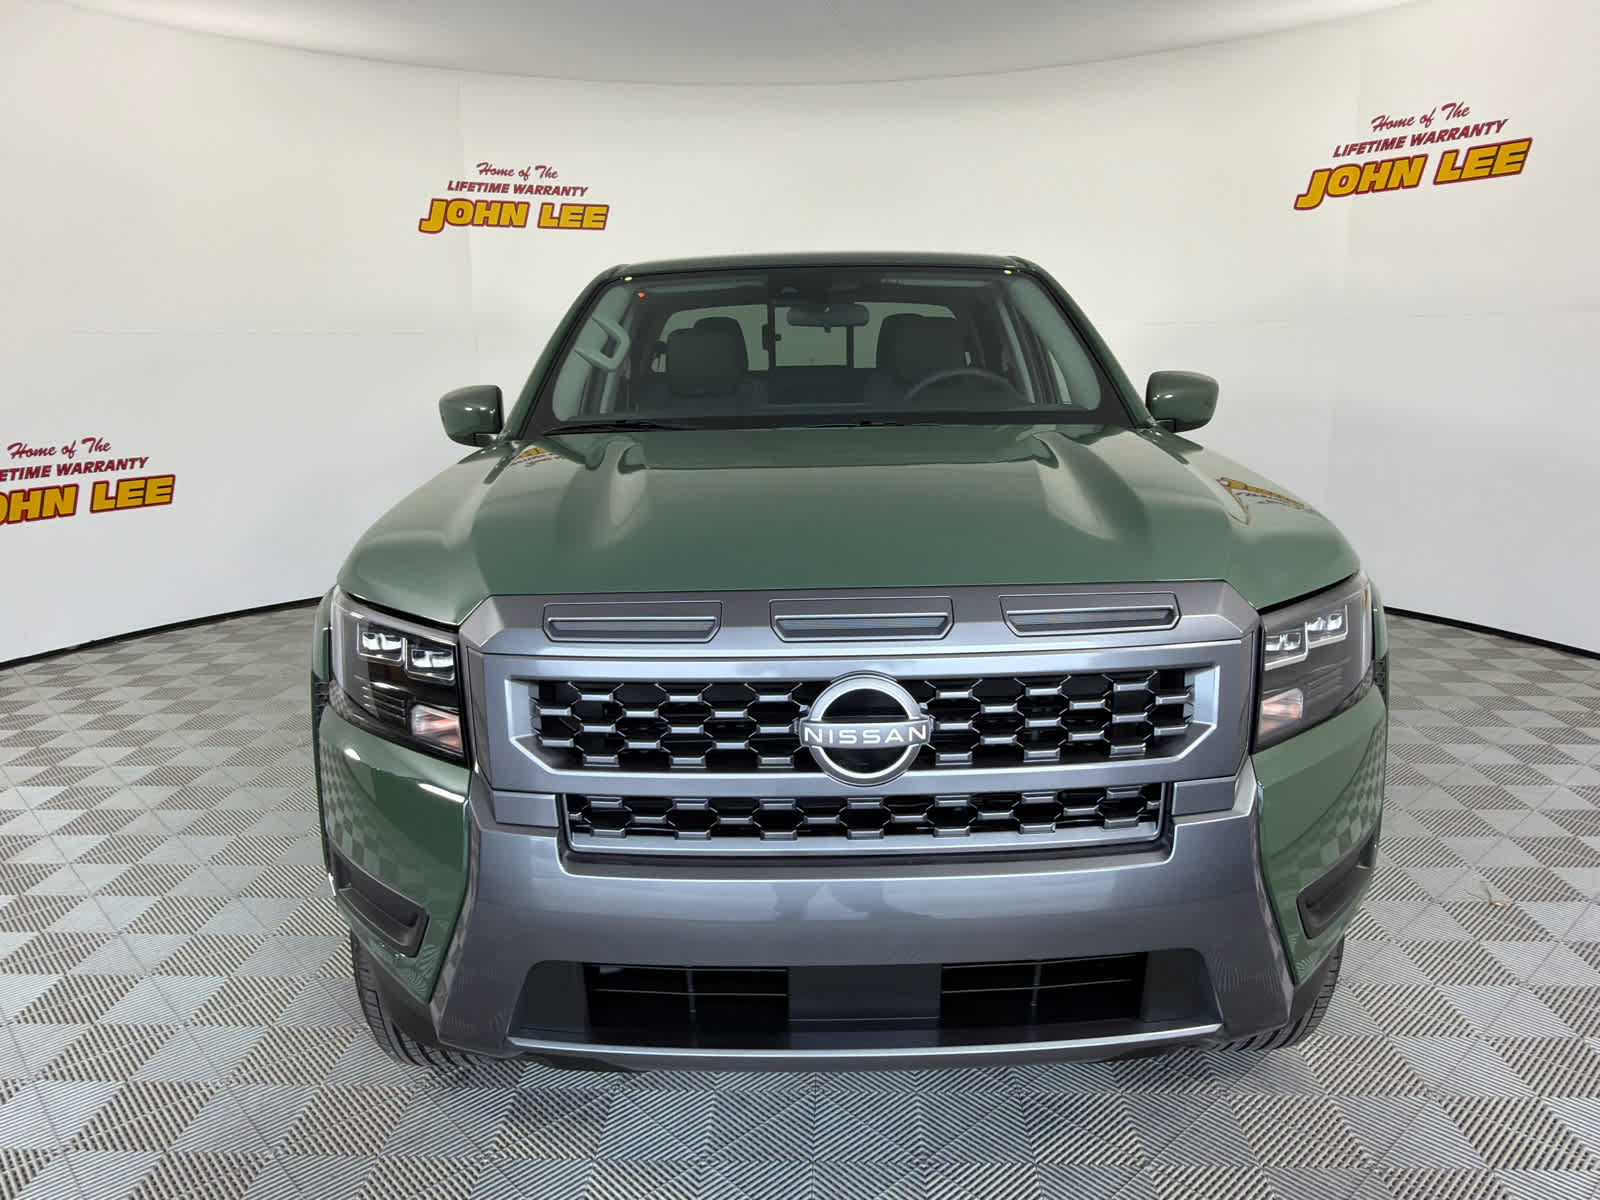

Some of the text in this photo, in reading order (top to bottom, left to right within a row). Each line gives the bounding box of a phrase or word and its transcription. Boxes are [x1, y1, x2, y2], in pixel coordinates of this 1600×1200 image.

[1370, 101, 1471, 133] Home of The
[1332, 119, 1508, 158] LIFETIME WARRANTY
[476, 162, 559, 181] Home of The
[1294, 137, 1533, 210] JOHN LEE
[447, 180, 588, 197] LIFETIME WARRANTY
[418, 198, 609, 233] JOHN LEE
[7, 437, 111, 459] Home of The
[56, 457, 149, 476] WARRANTY
[90, 474, 176, 513] LEE
[804, 725, 926, 744] NISSAN
